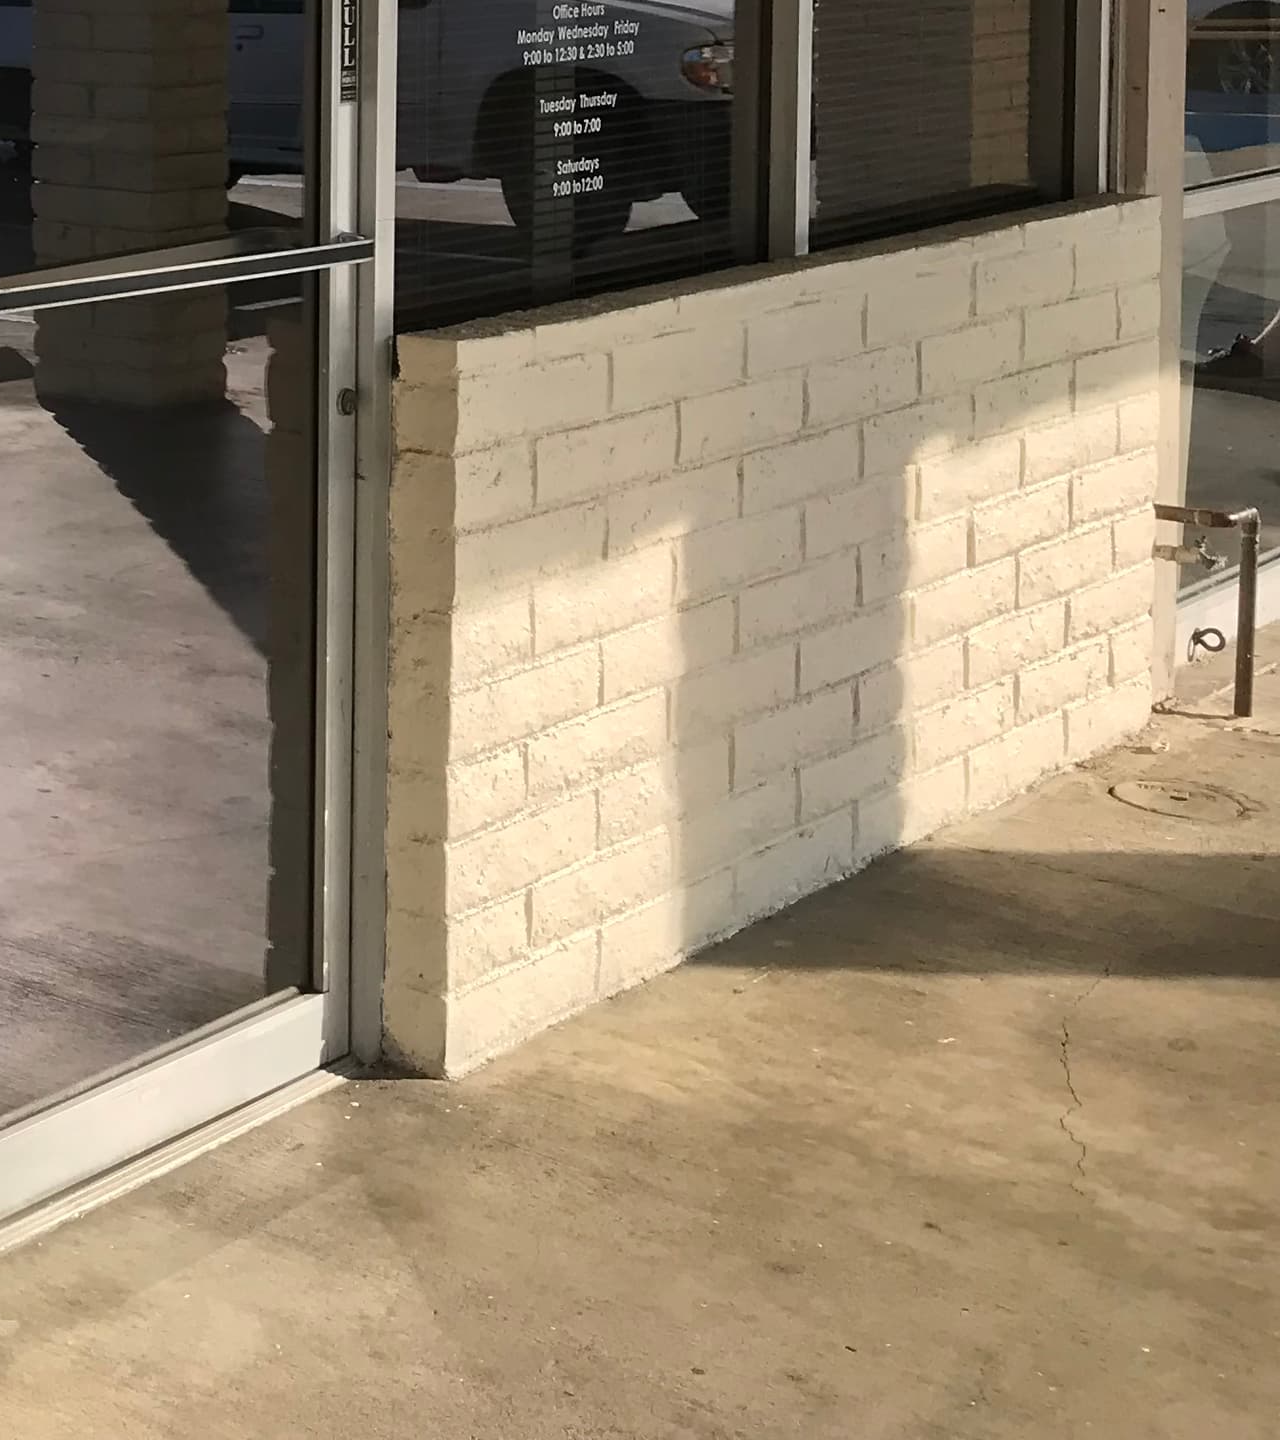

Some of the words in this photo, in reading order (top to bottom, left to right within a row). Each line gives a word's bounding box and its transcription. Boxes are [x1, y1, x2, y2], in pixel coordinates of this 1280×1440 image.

[553, 6, 579, 20] Office
[581, 3, 605, 17] Hours
[517, 29, 555, 45] Monday
[558, 23, 609, 41] Wednesday
[614, 20, 640, 37] Friday
[523, 49, 542, 66] 9:00
[543, 48, 552, 64] to
[555, 45, 578, 62] 12:30
[579, 44, 585, 59] &
[587, 42, 605, 58] 2:30
[606, 41, 615, 56] to
[617, 40, 634, 56] 5:00
[540, 96, 576, 114] Tuesday
[579, 91, 617, 108] Thursday
[554, 120, 572, 137] 9:00
[573, 119, 582, 135] to
[583, 117, 601, 134] 7:00
[557, 157, 599, 175] Saturdays
[553, 180, 571, 197] 9:00
